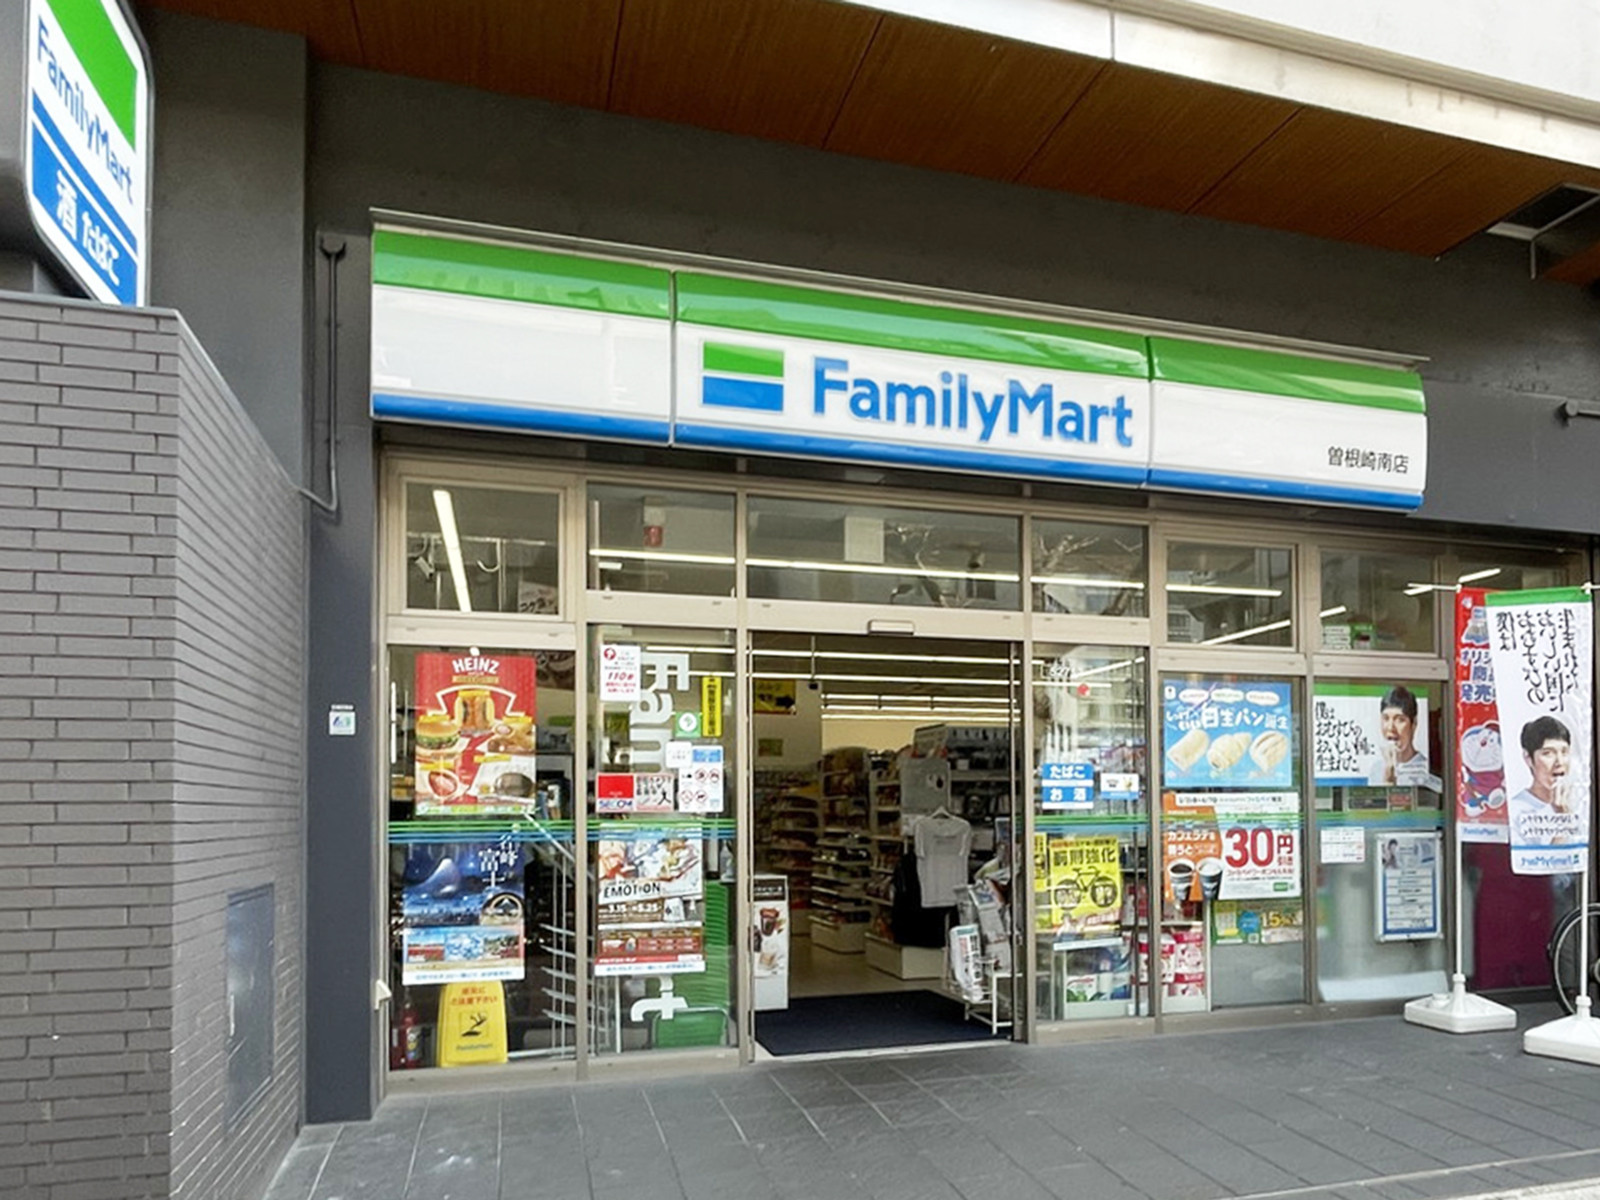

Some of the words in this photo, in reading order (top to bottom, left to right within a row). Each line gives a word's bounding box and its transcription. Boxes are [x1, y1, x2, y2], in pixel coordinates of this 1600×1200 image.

[36, 14, 134, 205] FamilyMart
[56, 169, 77, 241] 酒
[82, 210, 120, 287] たばこ
[812, 355, 1134, 448] FamilyMart
[1327, 446, 1410, 474] 曽根崎南店
[452, 657, 500, 673] HEINZ
[1050, 766, 1086, 779] たばこ
